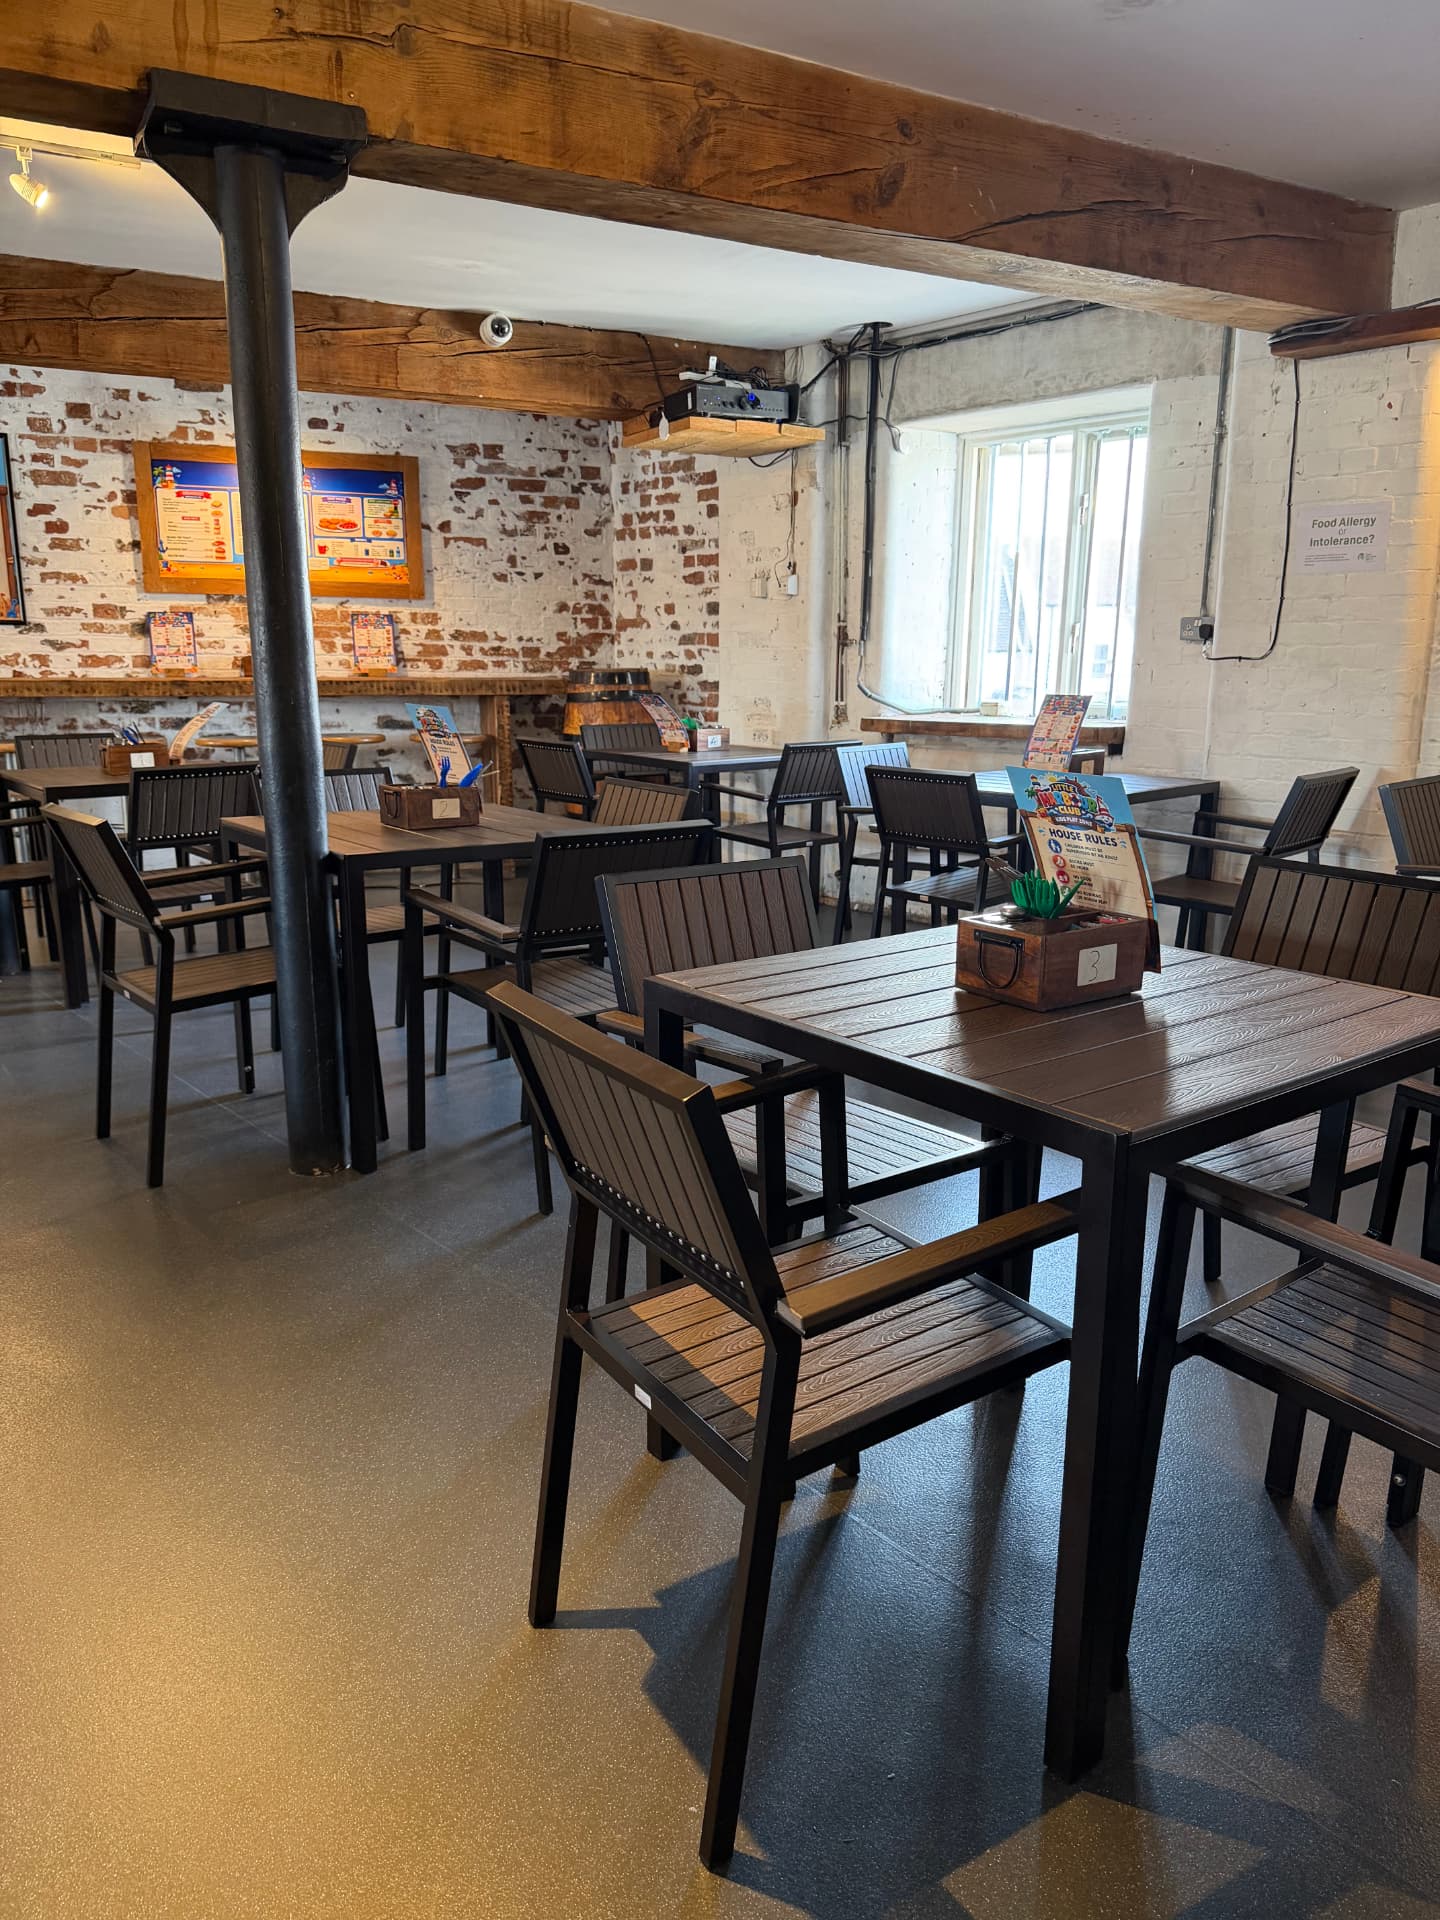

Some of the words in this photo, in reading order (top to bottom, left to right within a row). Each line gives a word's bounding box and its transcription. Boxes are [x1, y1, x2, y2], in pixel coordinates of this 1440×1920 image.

[1312, 518, 1337, 529] Food
[1339, 517, 1377, 527] Allergy
[1310, 534, 1375, 547] Intolerance?
[1051, 783, 1075, 792] LITTLE
[440, 800, 448, 818] 2
[1038, 791, 1098, 814] HARBOUR
[1058, 805, 1081, 816] CLUB
[1049, 827, 1083, 842] HOUSE
[1084, 833, 1118, 847] RULES
[1089, 950, 1100, 982] 3
